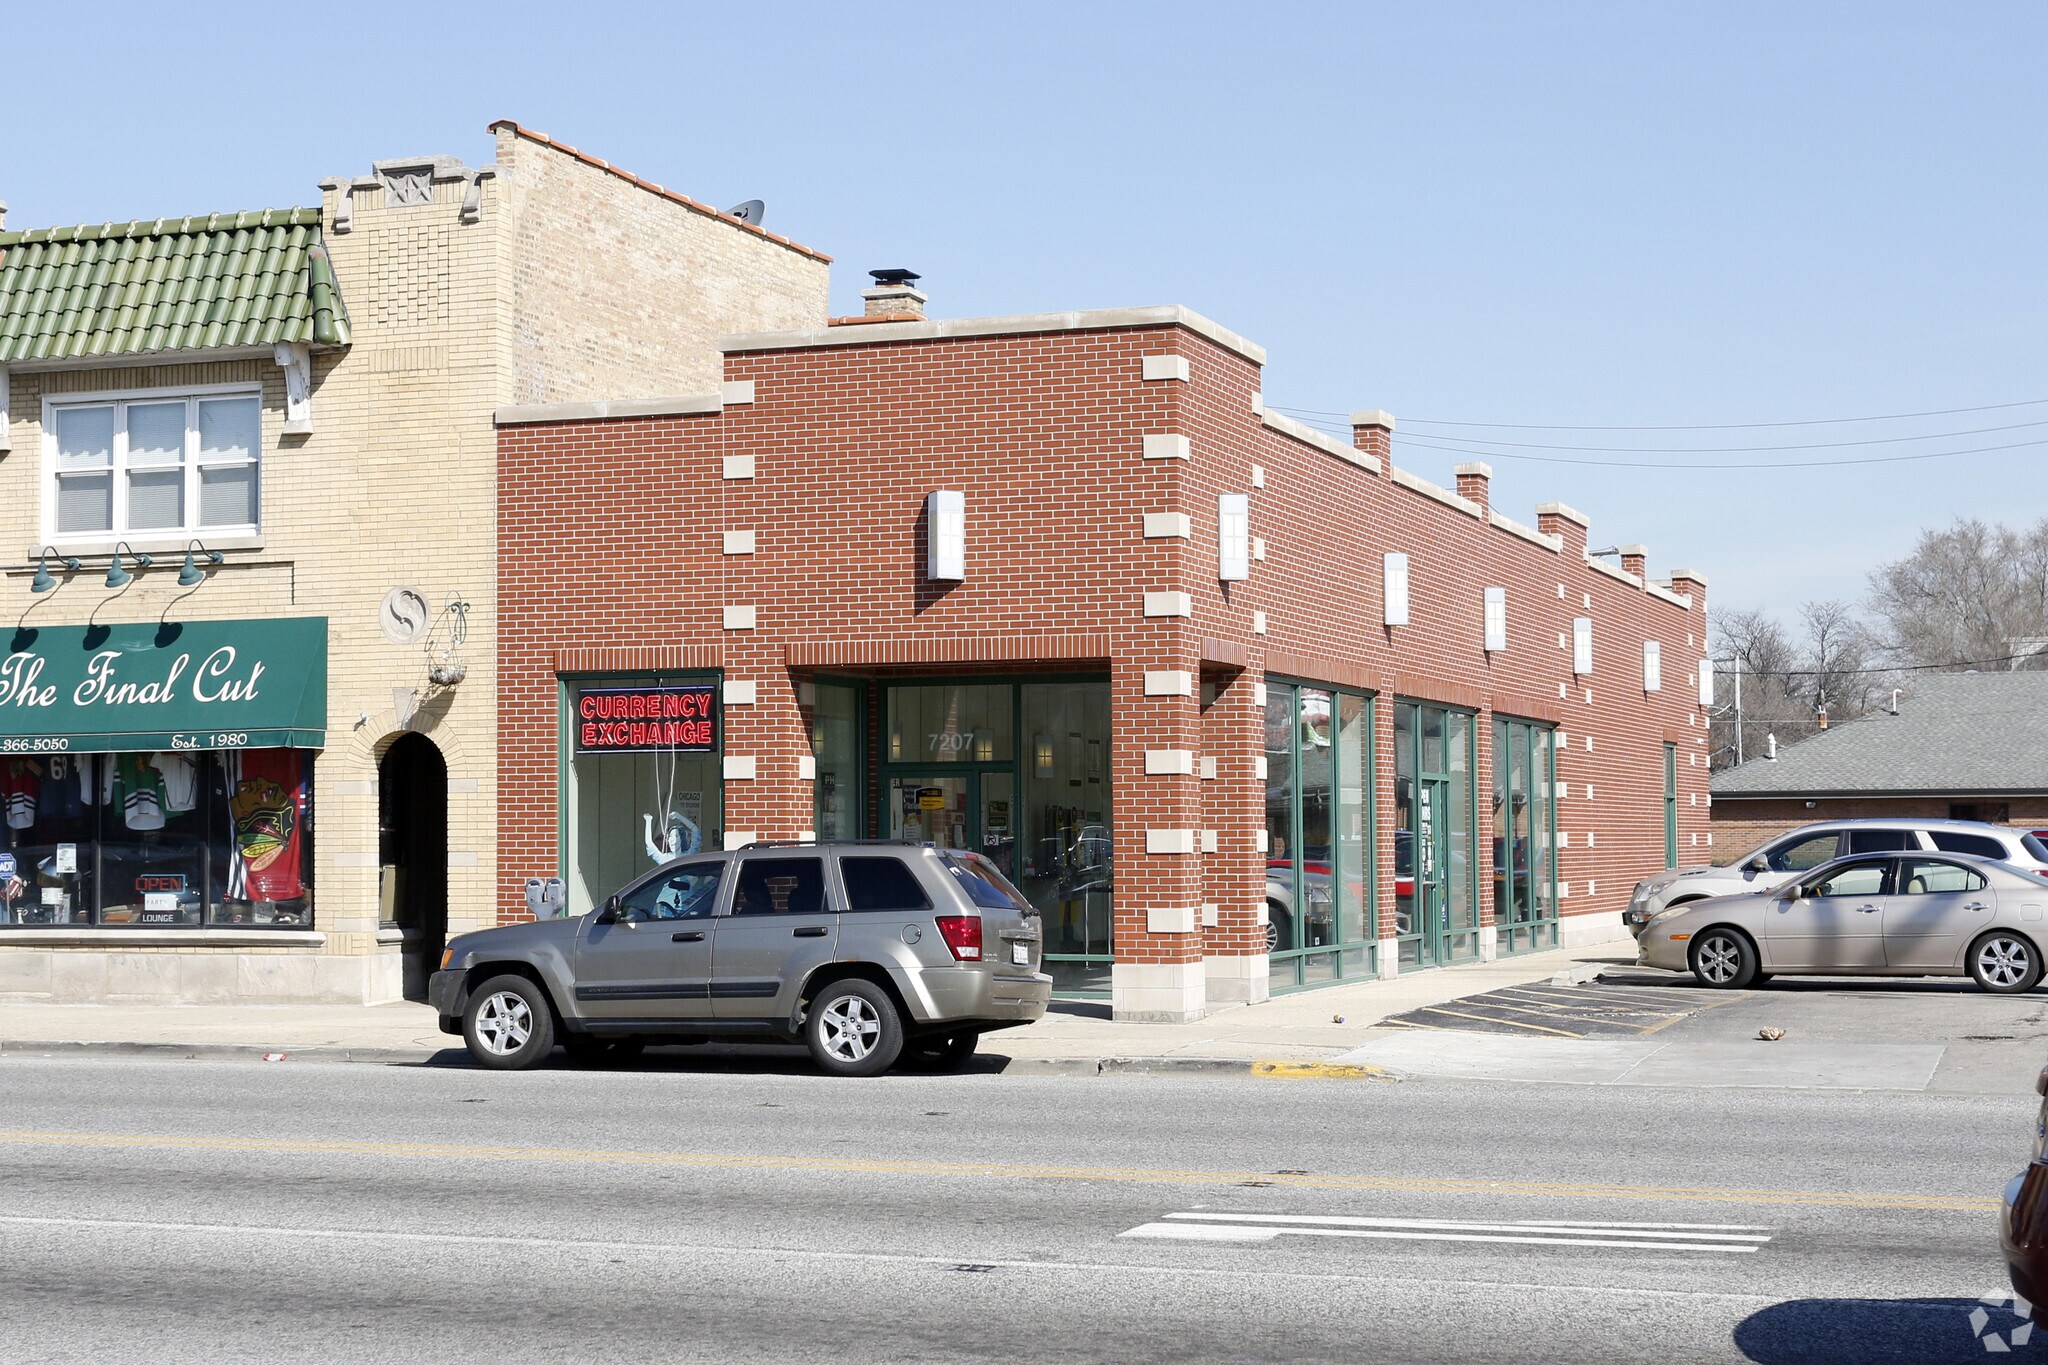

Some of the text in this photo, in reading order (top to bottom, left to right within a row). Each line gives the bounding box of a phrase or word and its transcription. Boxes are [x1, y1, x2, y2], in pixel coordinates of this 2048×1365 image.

[0, 645, 266, 708] The Final Cut
[580, 693, 711, 719] CURRENCY
[171, 732, 248, 748] Est. 1980
[581, 721, 712, 746] EXCHANGE
[928, 733, 974, 751] 7207
[678, 792, 701, 801] CHICAGO
[0, 861, 14, 872] ADT
[135, 877, 182, 891] OPEN
[142, 914, 174, 923] LOUNGE
